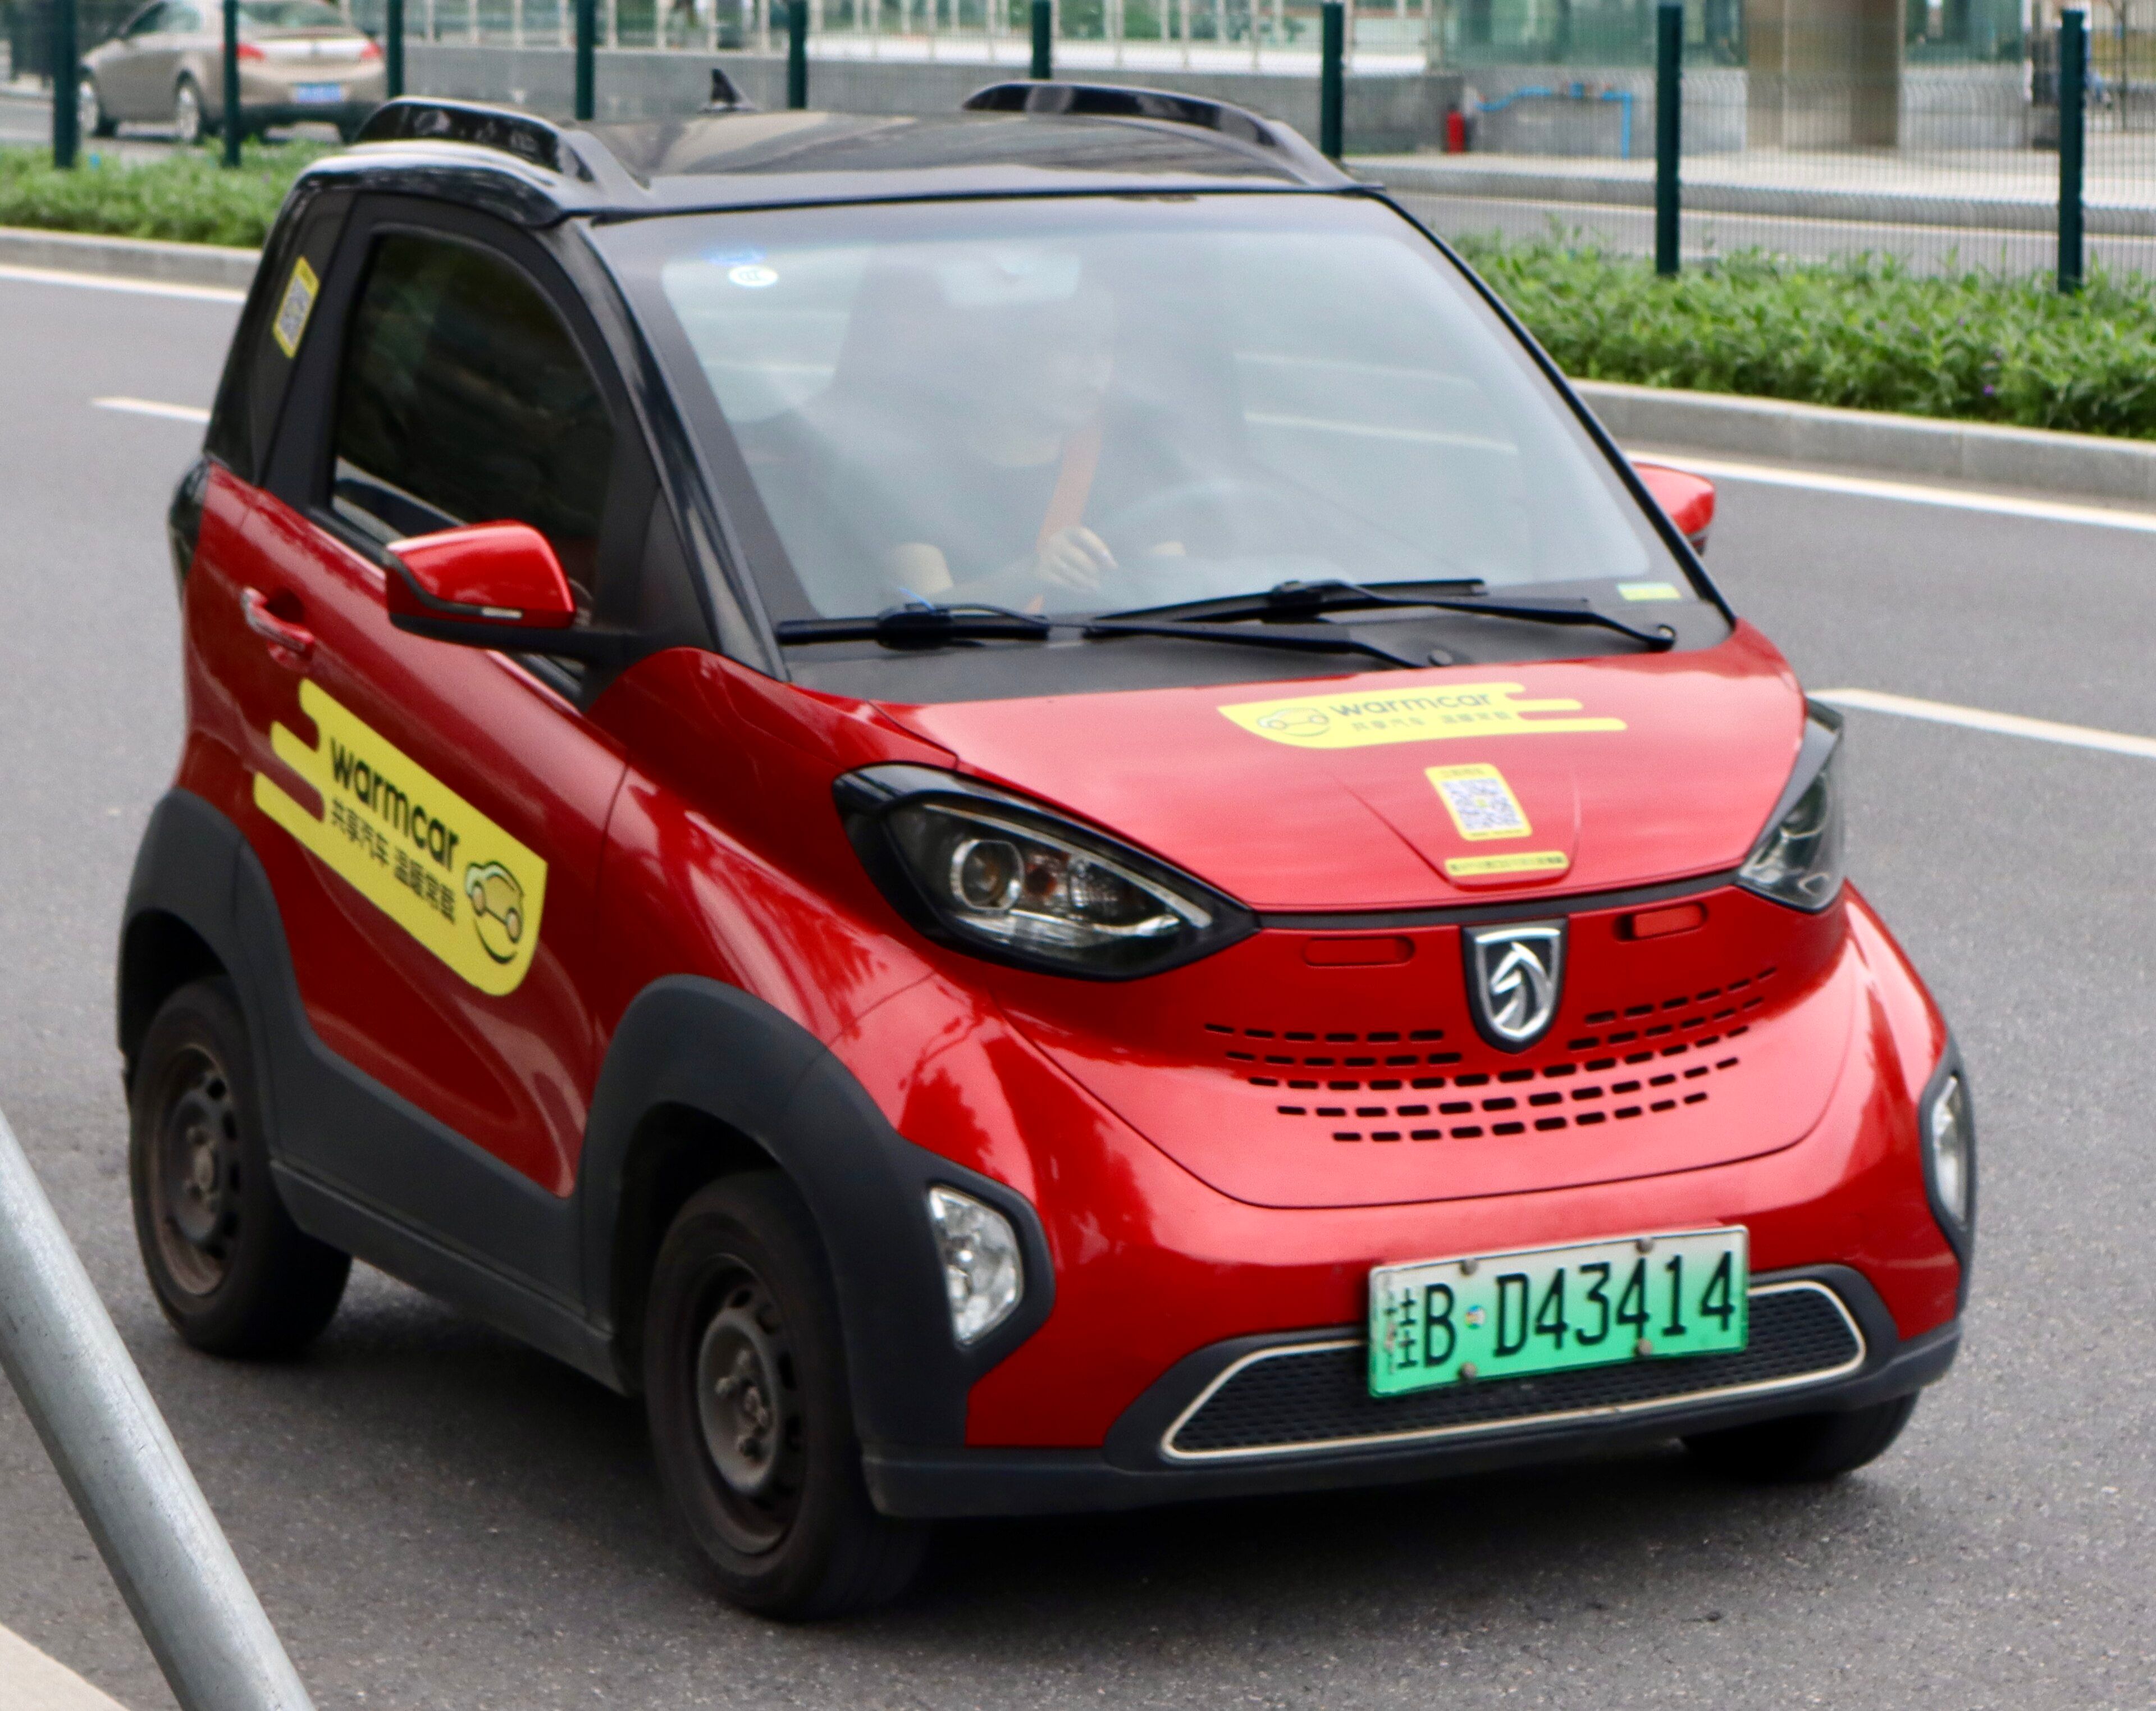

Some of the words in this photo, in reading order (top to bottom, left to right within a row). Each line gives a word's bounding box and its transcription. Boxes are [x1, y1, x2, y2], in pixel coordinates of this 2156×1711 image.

[1329, 693, 1491, 717] warmcar
[330, 736, 460, 872] warmcar
[331, 796, 390, 867] 共享汽车
[1493, 1251, 1736, 1357] D43414
